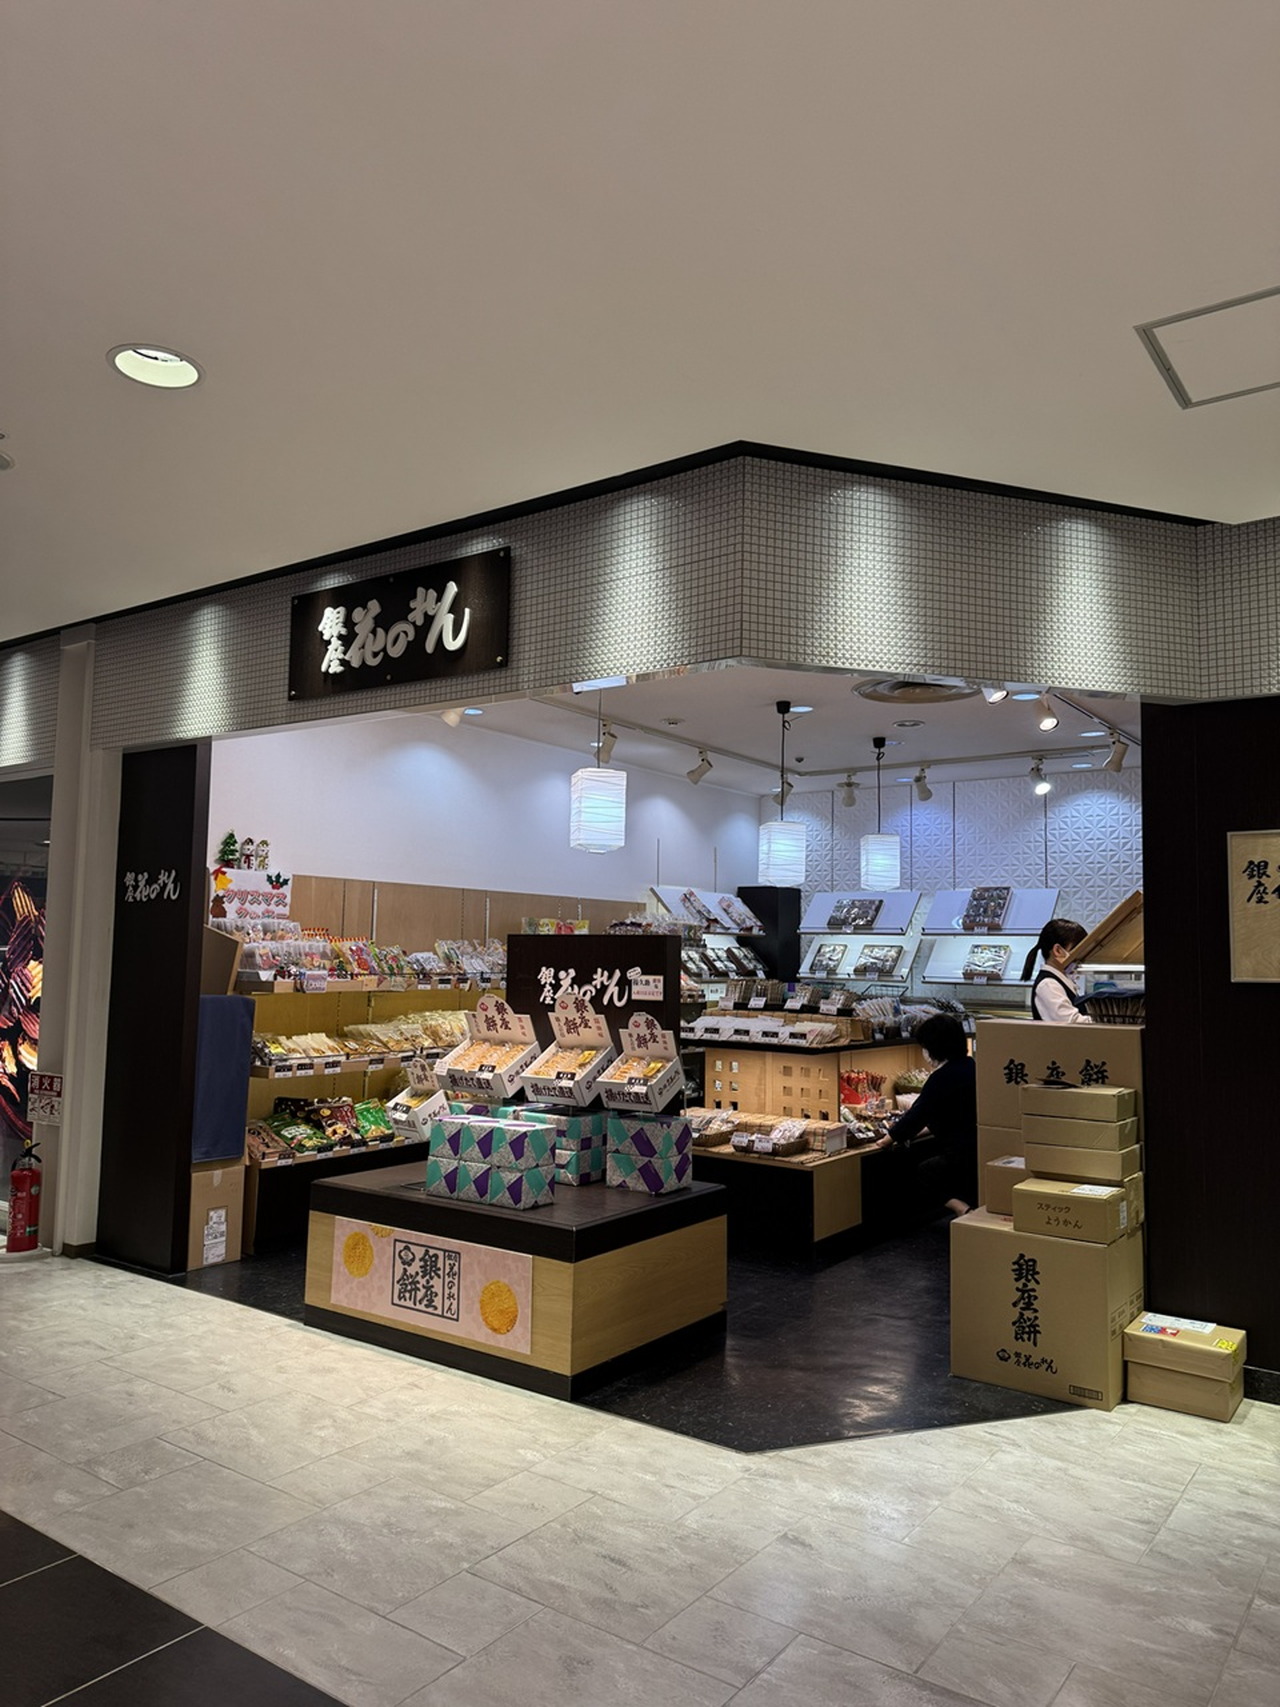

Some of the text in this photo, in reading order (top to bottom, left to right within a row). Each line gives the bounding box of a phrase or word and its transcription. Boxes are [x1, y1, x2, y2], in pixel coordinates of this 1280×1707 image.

[1242, 860, 1271, 904] 銀座
[225, 889, 288, 907] クリスマス
[31, 1075, 61, 1091] 消火器
[1037, 1202, 1071, 1214] スティック
[1045, 1216, 1083, 1229] ようかん
[1011, 1253, 1042, 1347] 銀座餅
